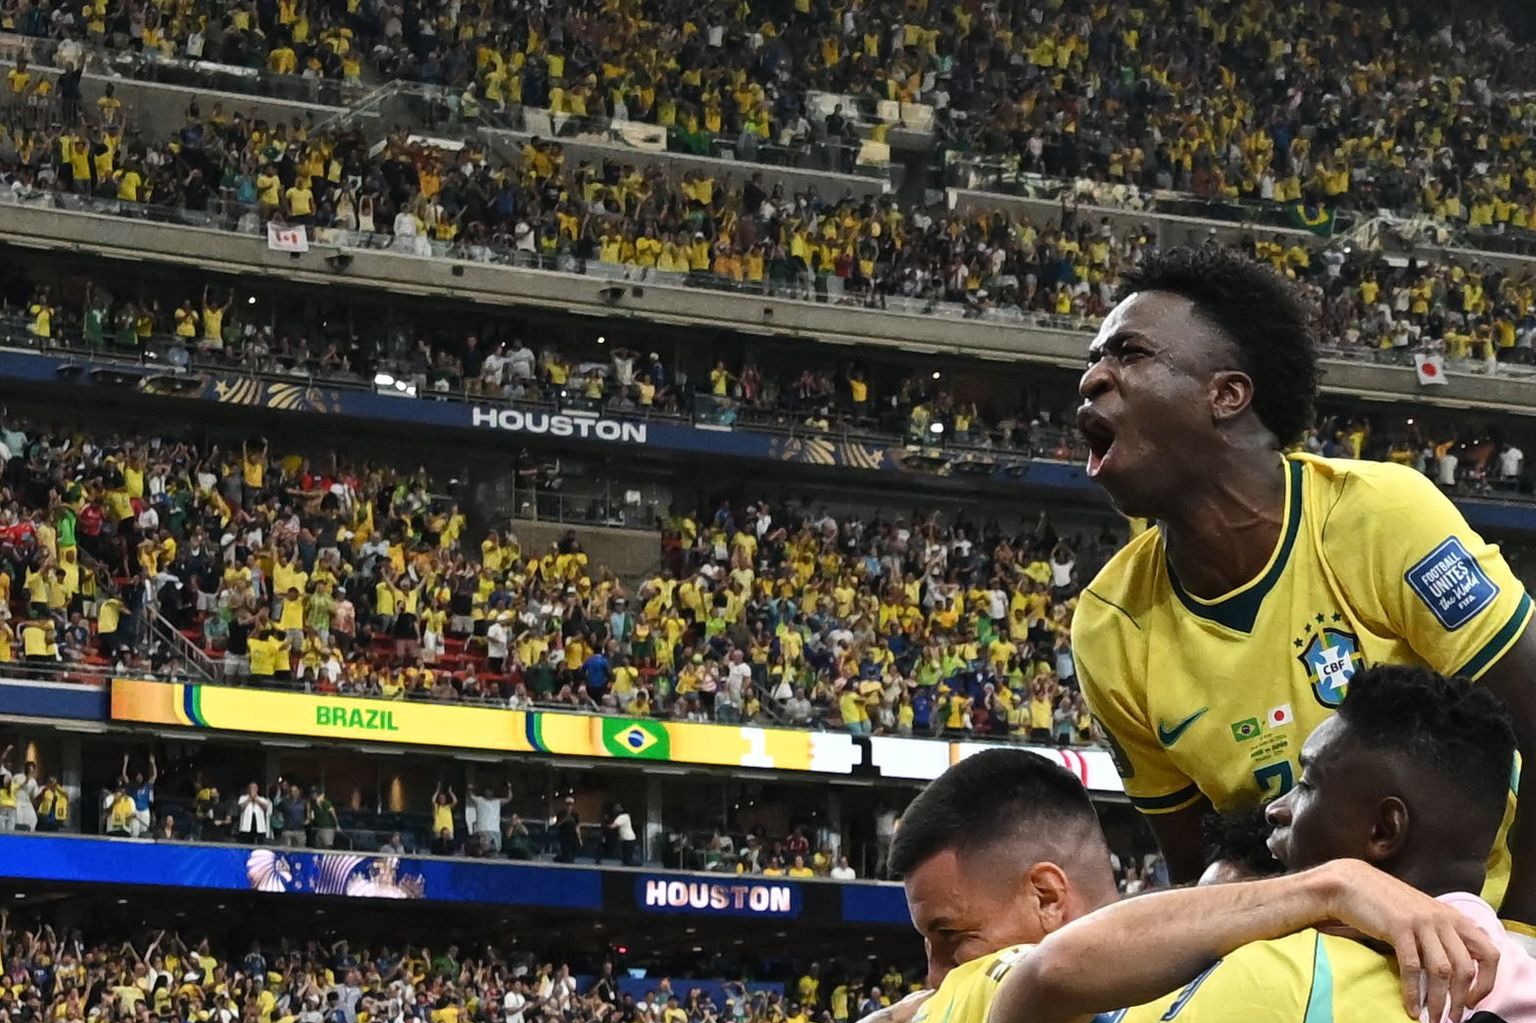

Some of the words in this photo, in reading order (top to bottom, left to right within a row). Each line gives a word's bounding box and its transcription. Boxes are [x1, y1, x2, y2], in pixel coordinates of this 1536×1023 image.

[472, 406, 647, 443] HOUSTON
[1421, 551, 1461, 586] FOOTBALL
[1428, 561, 1469, 598] UNITES
[1439, 596, 1457, 611] the
[1457, 594, 1477, 610] FIFA
[1323, 659, 1346, 676] CBF
[316, 705, 399, 731] BRAZIL
[740, 727, 775, 768] 1
[1253, 760, 1294, 803] 7
[646, 880, 791, 912] HOUSTON
